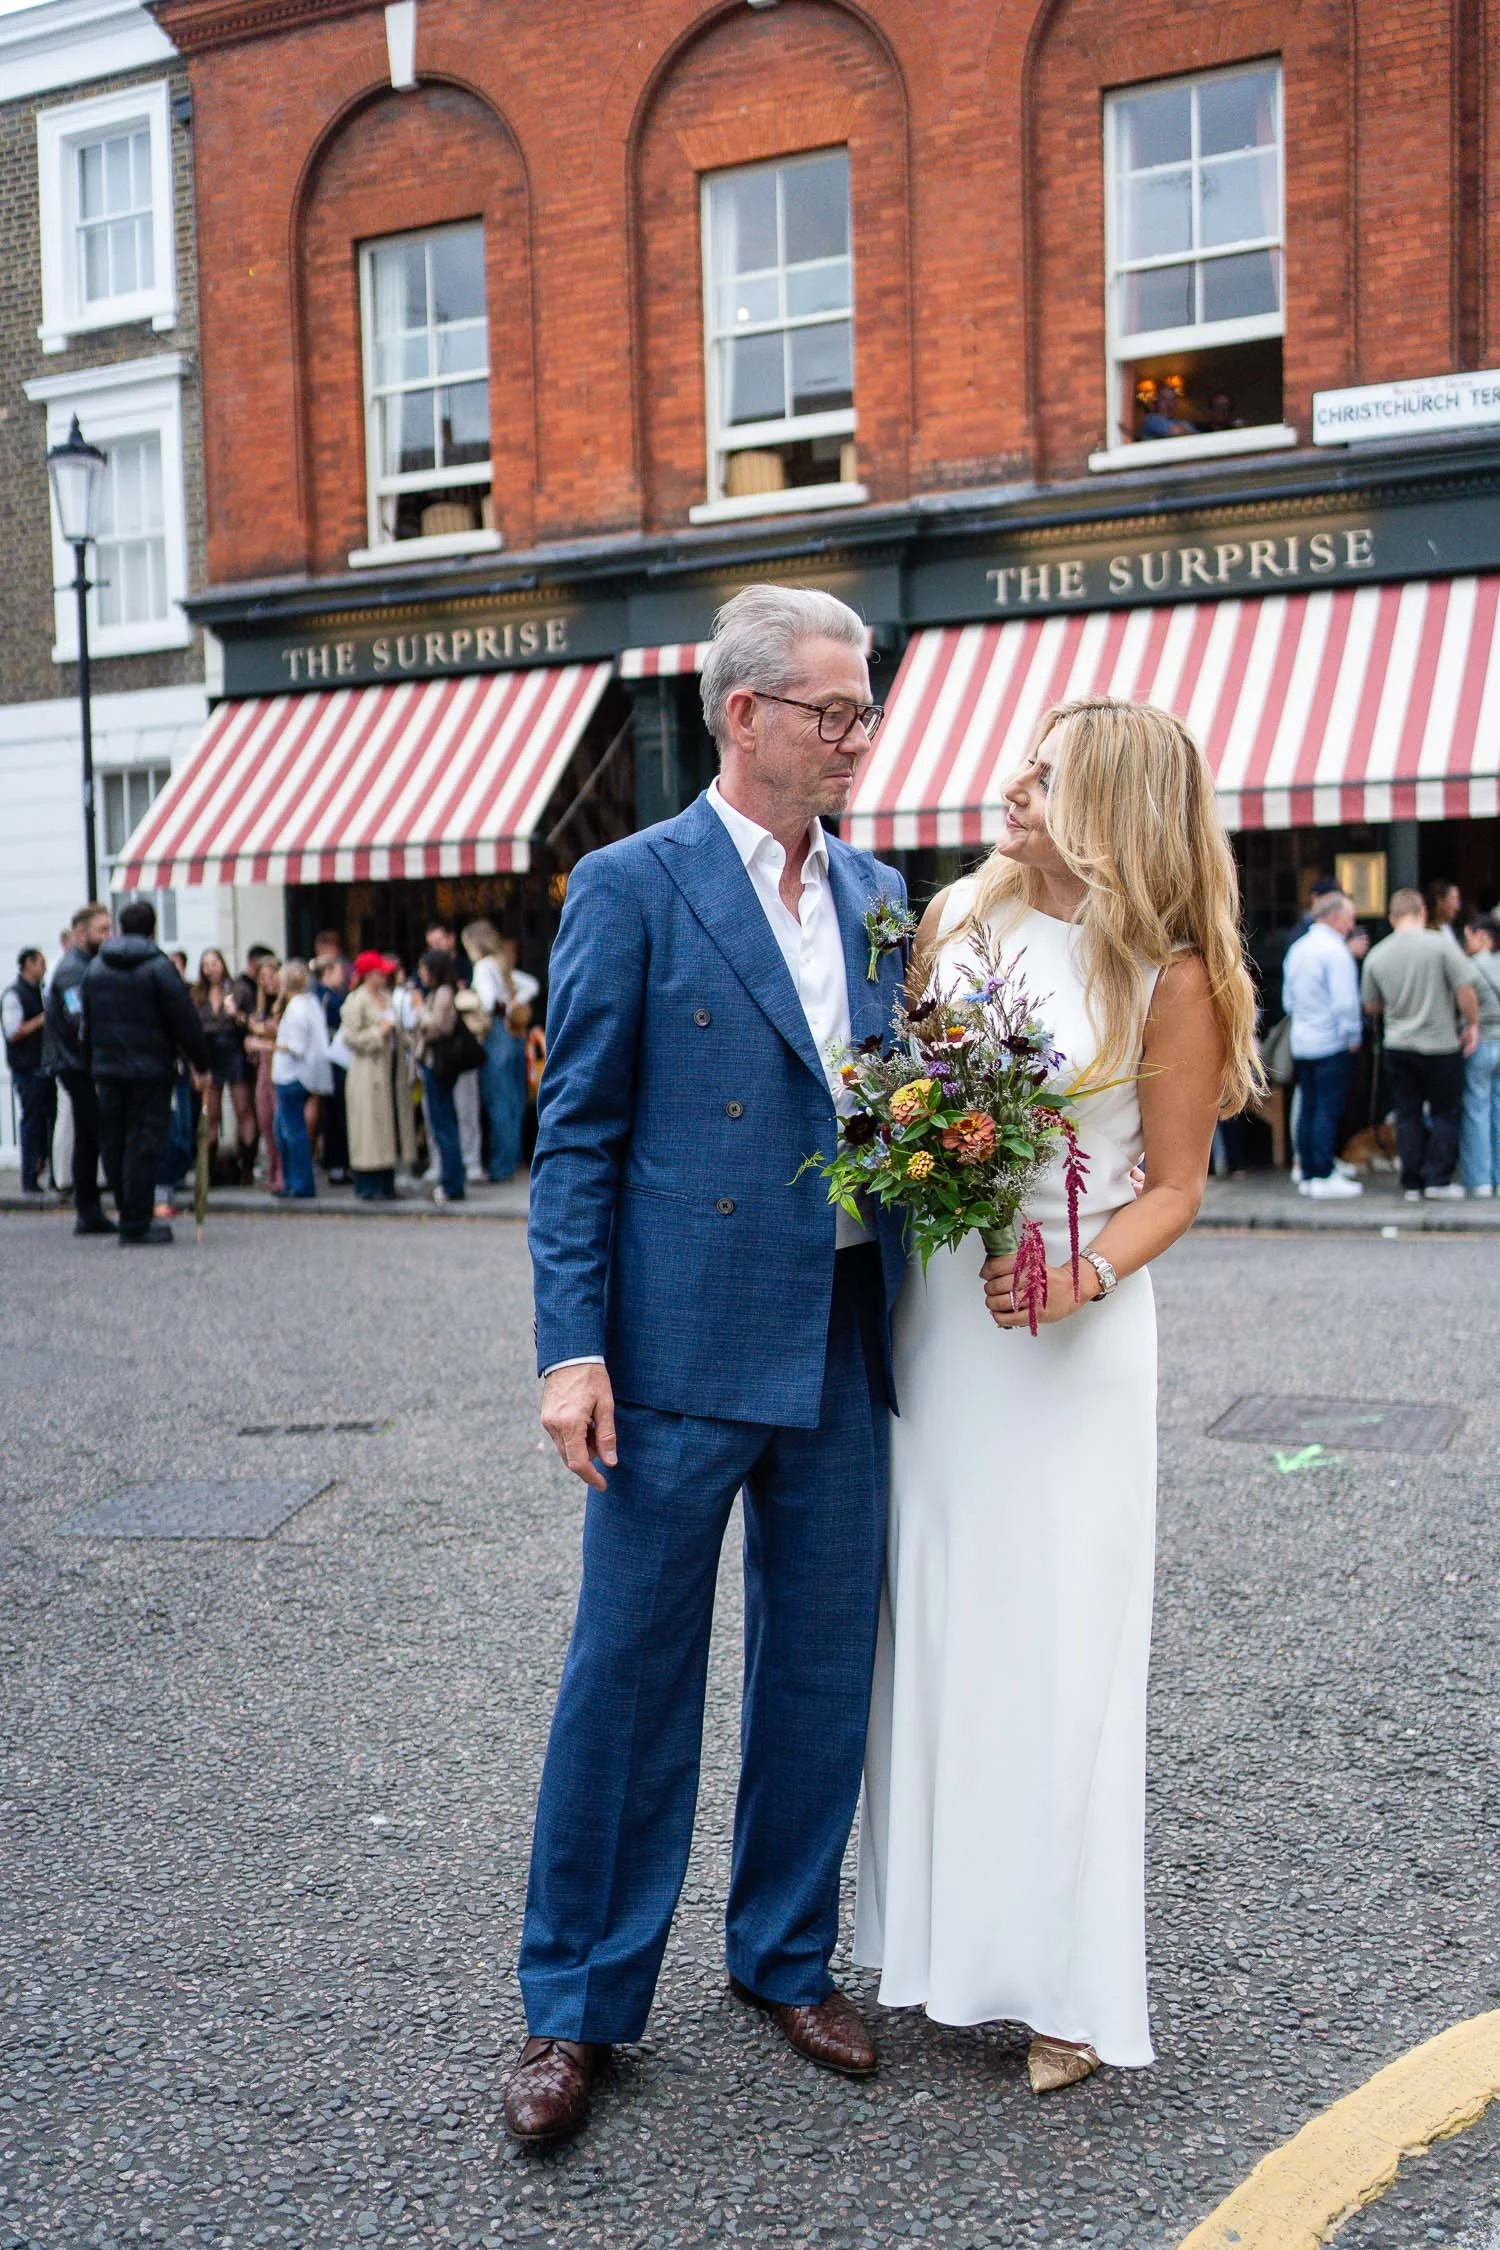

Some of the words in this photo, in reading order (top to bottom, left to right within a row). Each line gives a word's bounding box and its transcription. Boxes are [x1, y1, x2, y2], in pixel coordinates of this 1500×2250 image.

[1317, 392, 1460, 425] CHRISTCHURCH
[985, 560, 1088, 606] THE
[1108, 528, 1376, 595] SURPRISE
[282, 641, 357, 681] THE
[372, 617, 569, 672] SURPRISE
